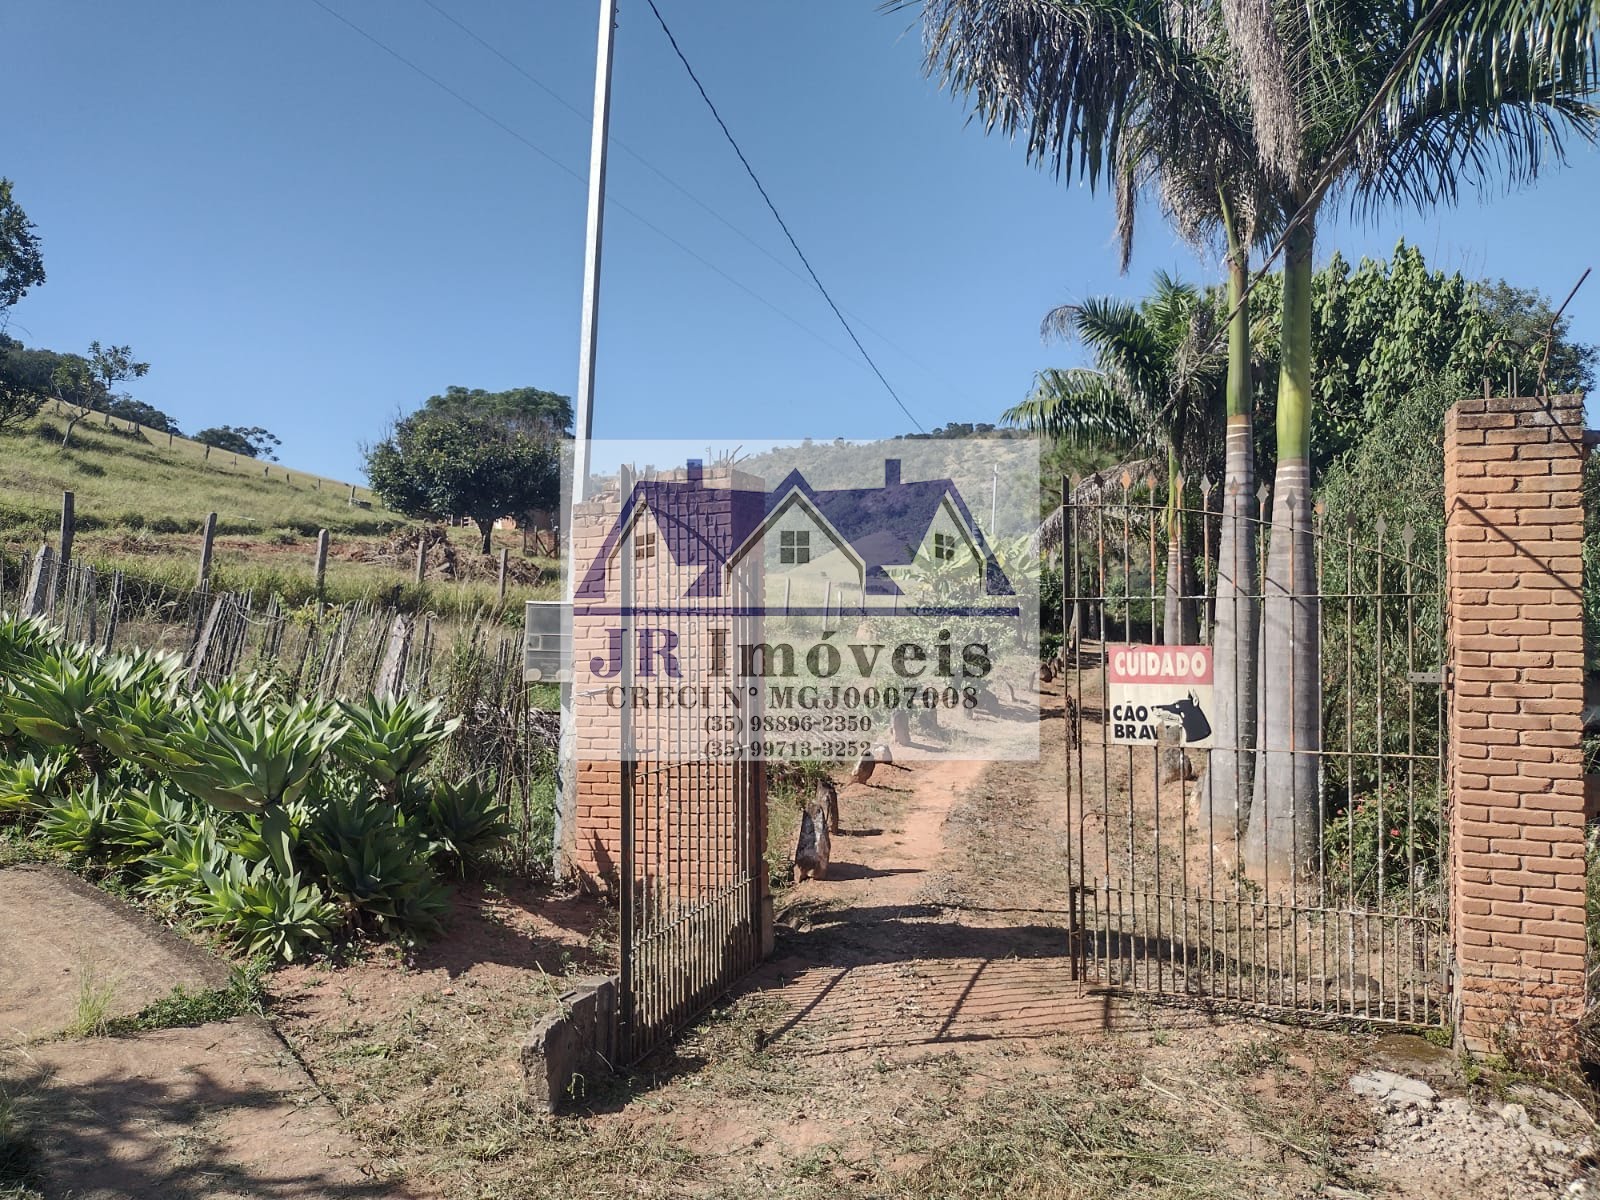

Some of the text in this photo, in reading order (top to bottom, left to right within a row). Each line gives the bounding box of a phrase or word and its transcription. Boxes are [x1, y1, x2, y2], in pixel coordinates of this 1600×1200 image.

[1114, 651, 1207, 678] CUIDADO
[1112, 700, 1149, 722] CÃO
[1114, 723, 1159, 740] BRAV
